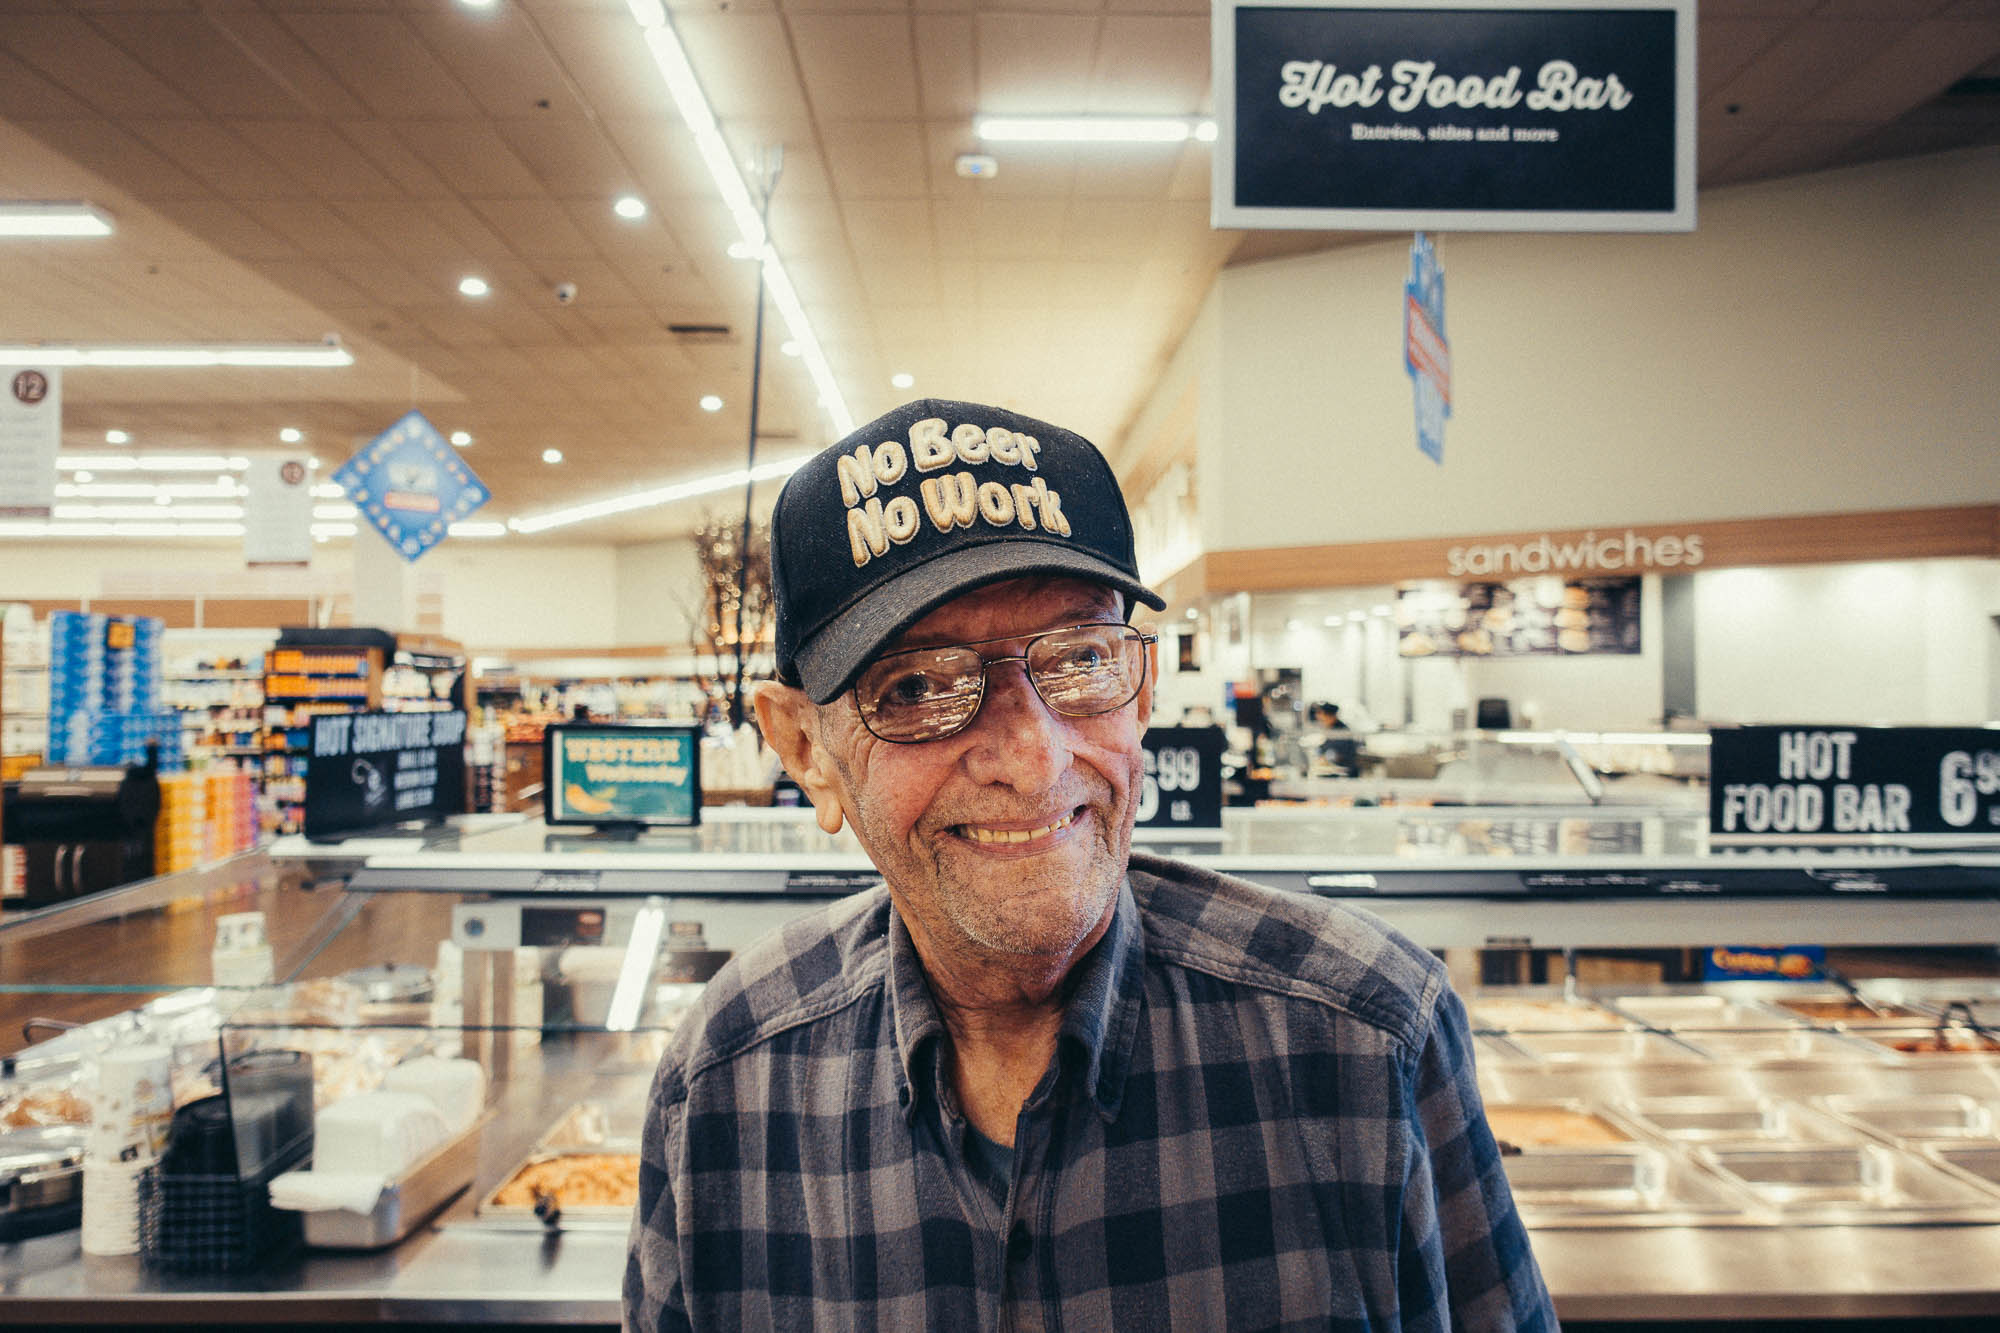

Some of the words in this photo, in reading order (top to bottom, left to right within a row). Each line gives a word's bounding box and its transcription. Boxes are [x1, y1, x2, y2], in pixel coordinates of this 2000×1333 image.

[1279, 60, 1383, 114] Hot
[1388, 60, 1523, 112] Food
[1526, 59, 1633, 112] Bar
[1427, 123, 1474, 141] sides
[1475, 124, 1510, 141] and
[1513, 126, 1560, 142] more
[17, 374, 42, 400] 12
[837, 440, 908, 508] No
[908, 418, 1041, 472] Beer
[847, 496, 920, 568] No
[920, 472, 1072, 538] Work
[1447, 530, 1704, 577] sandwiches
[314, 716, 352, 757] HOT
[1778, 731, 1857, 780] HOT
[1722, 783, 1824, 832] FOOD
[1832, 783, 1911, 832] BAR
[1940, 750, 2000, 827] 69
